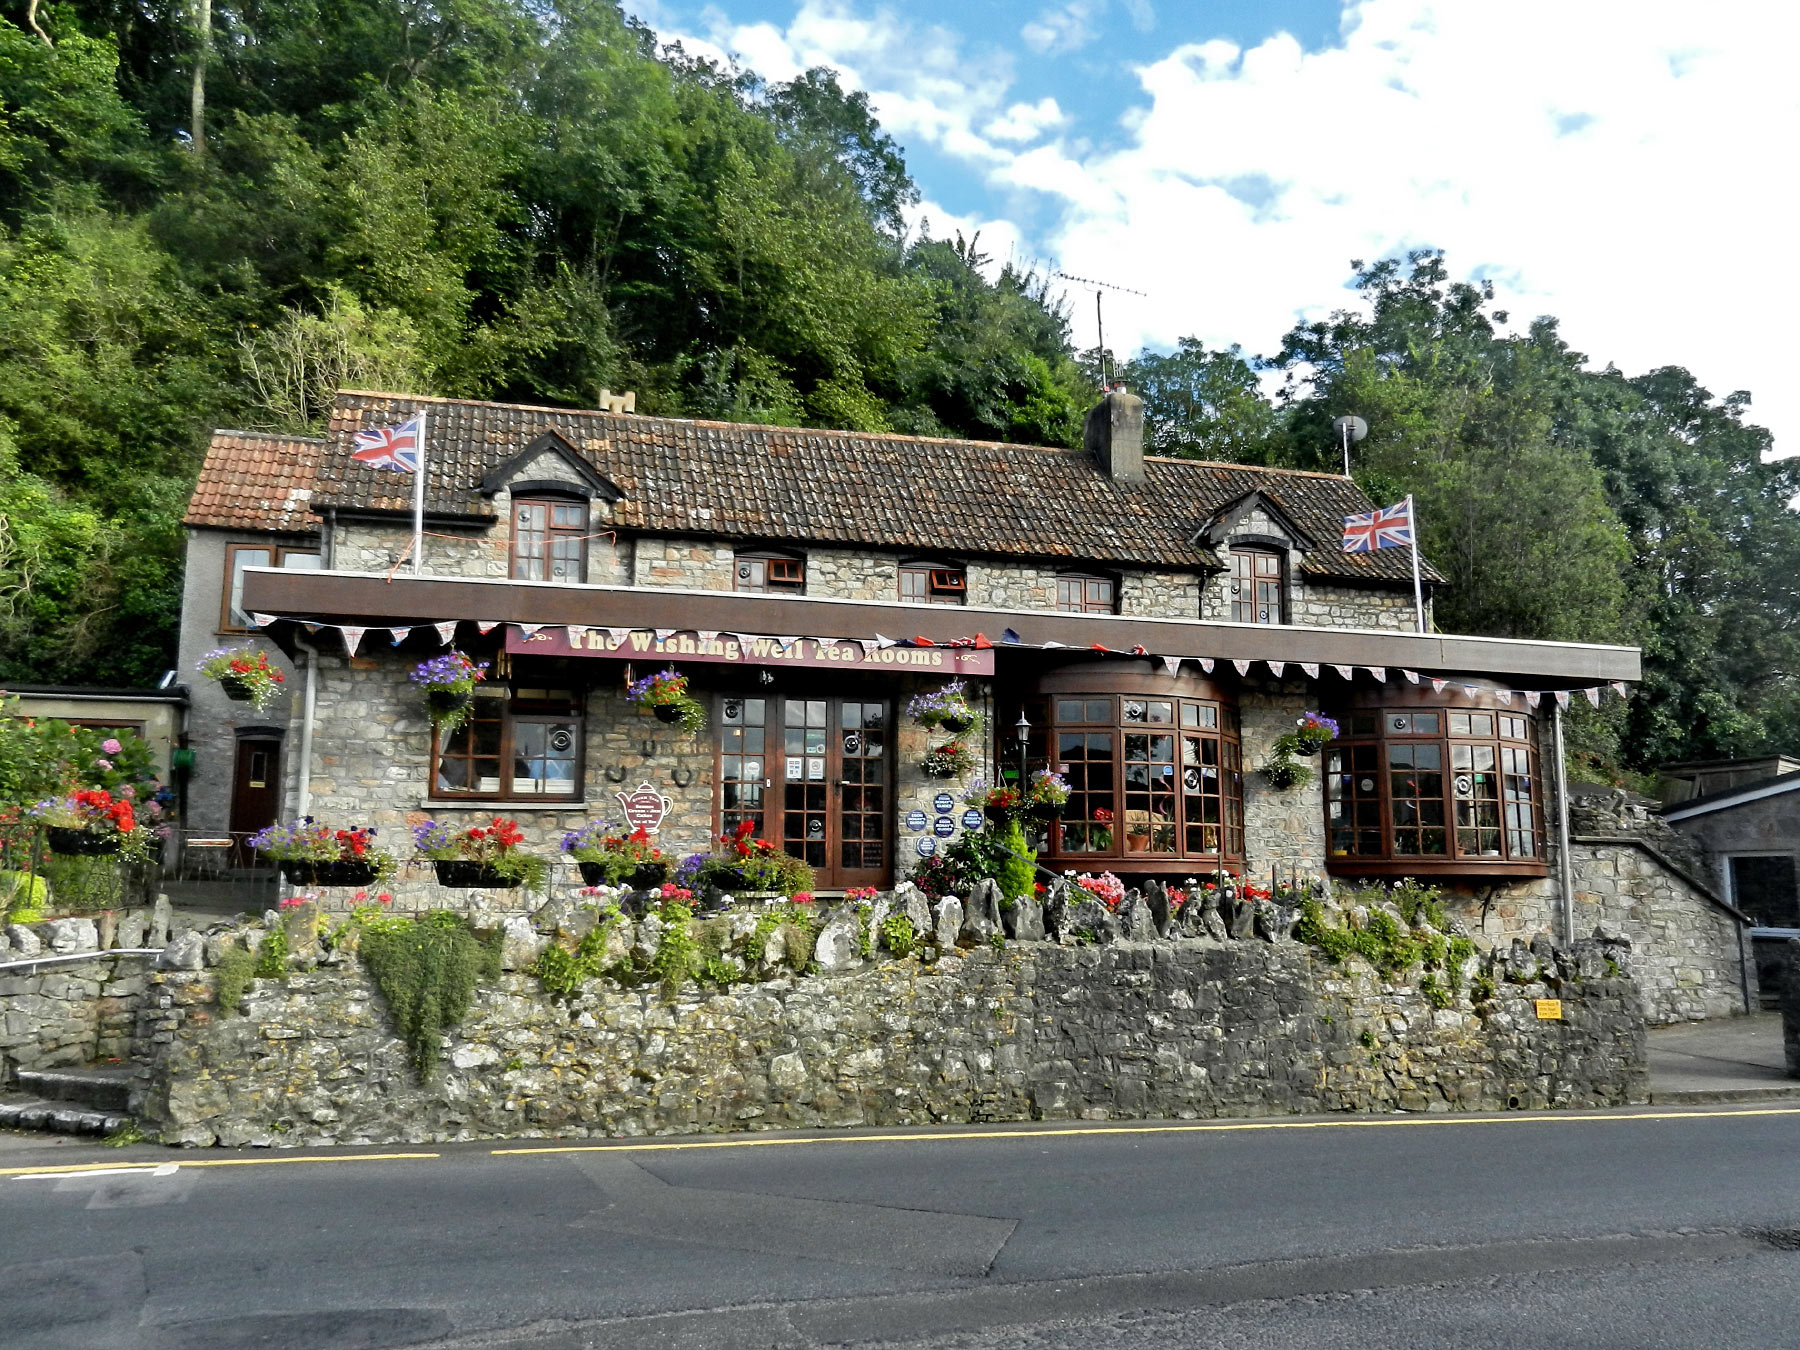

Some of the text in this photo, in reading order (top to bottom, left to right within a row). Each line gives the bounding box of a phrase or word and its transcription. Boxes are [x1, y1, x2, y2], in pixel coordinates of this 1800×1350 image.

[570, 629, 943, 667] The Wishing Well Tea Rooms
